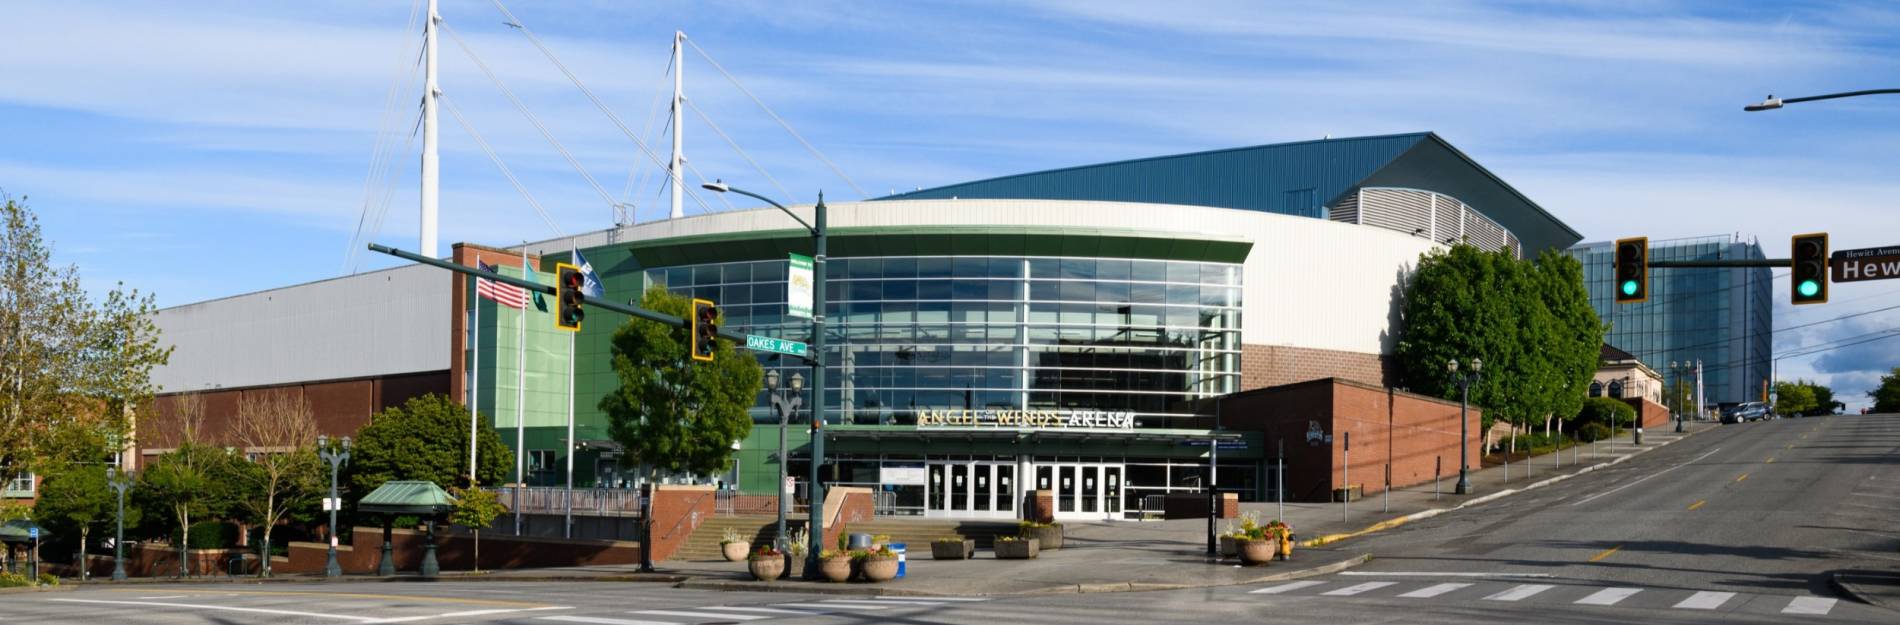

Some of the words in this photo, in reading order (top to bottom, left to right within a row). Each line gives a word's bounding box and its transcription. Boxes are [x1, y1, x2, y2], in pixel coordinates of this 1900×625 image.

[748, 336, 775, 350] OAKES
[780, 341, 794, 353] AVE
[917, 409, 981, 425] ANGEL
[997, 409, 1063, 426] WINDS
[1069, 410, 1134, 428] ARENA
